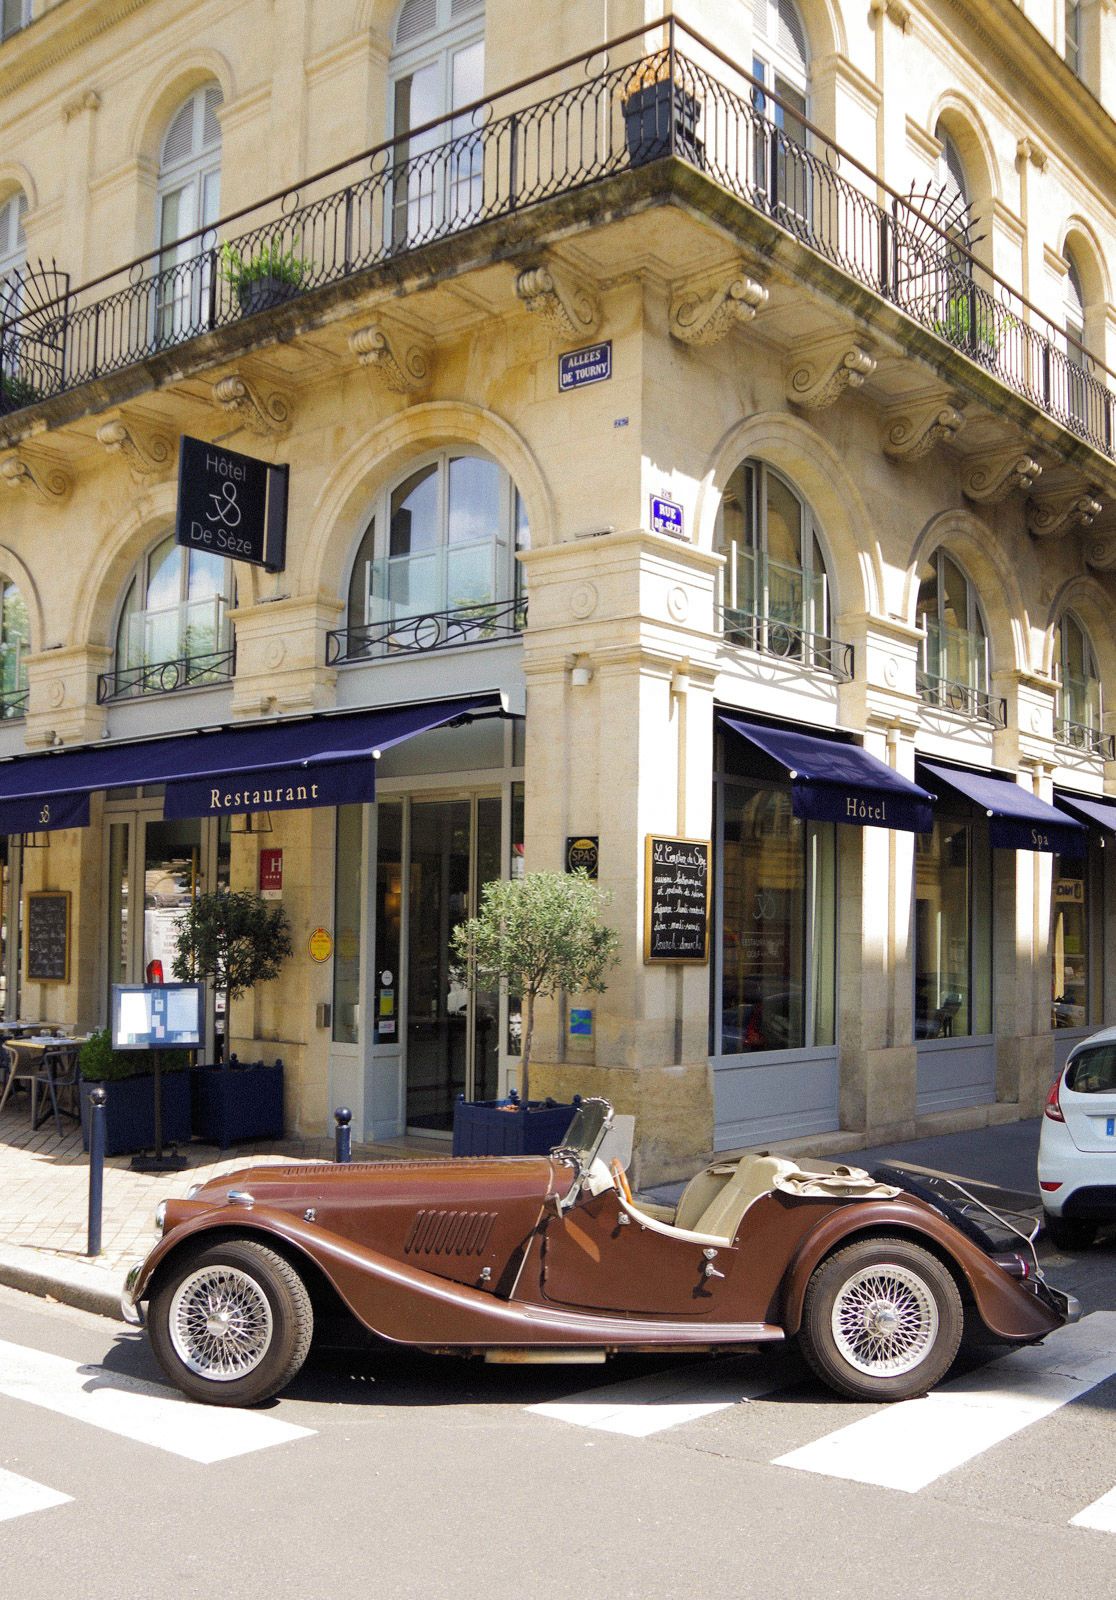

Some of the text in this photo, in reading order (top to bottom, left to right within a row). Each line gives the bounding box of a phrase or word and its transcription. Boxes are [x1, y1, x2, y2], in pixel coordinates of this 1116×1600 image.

[568, 350, 601, 368] ALLEES
[562, 362, 608, 384] DE TOURNY
[206, 453, 246, 481] Hôtel
[659, 503, 676, 519] RUE
[191, 521, 252, 554] De Sèze
[210, 784, 319, 808] Restaurant
[846, 797, 887, 820] Hôtel
[1031, 828, 1049, 850] Spa
[271, 858, 282, 872] H
[572, 850, 597, 862] SPAS
